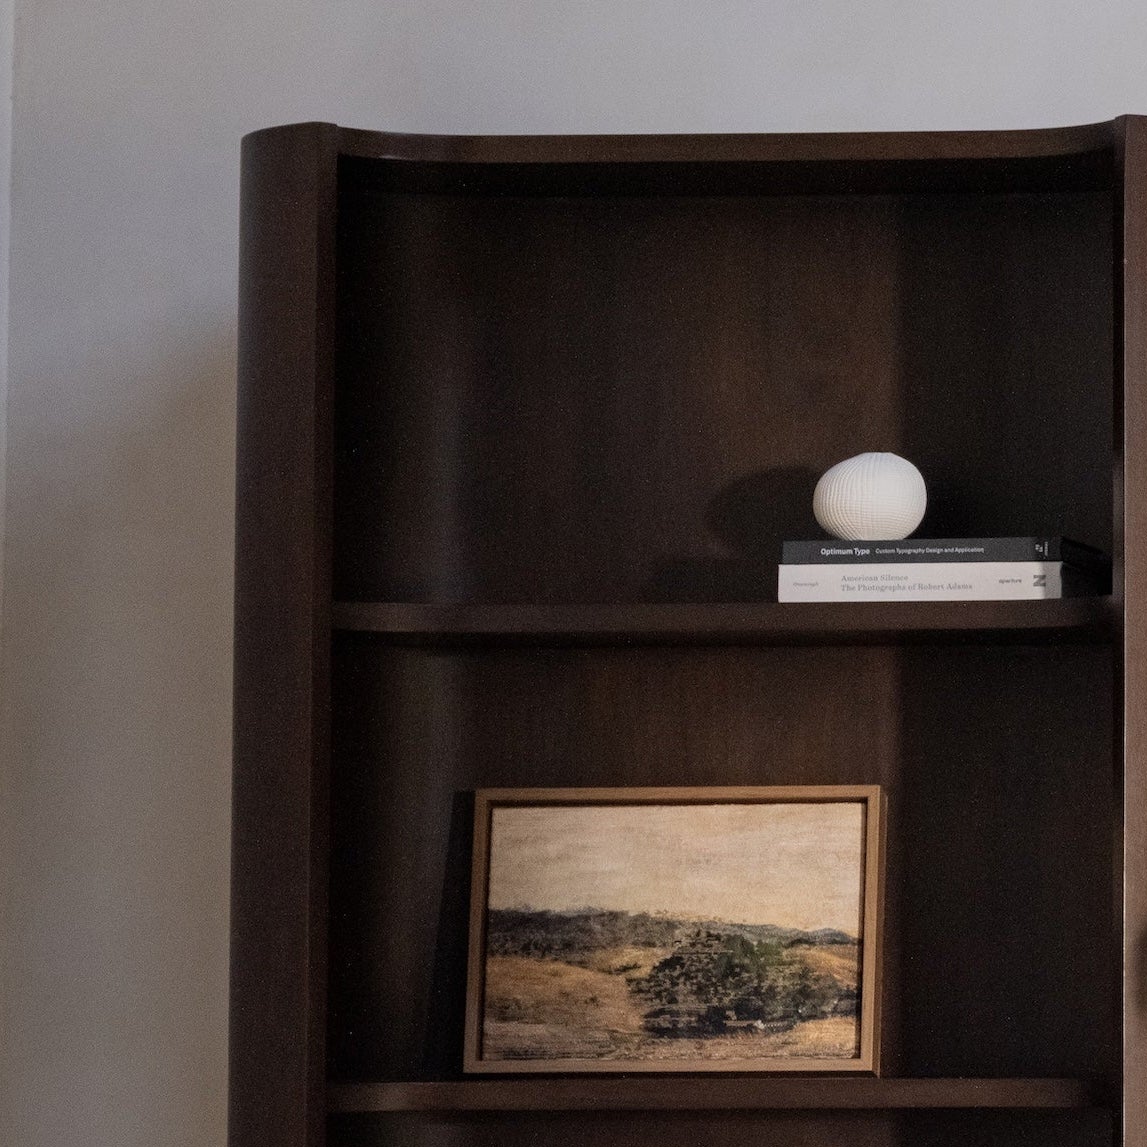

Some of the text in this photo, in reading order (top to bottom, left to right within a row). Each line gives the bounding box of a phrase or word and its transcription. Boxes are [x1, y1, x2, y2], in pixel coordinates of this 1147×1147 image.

[820, 547, 870, 557] Optimum Type
[880, 574, 908, 582] Silence
[841, 583, 855, 591] The
[857, 583, 906, 593] Photographs
[908, 583, 916, 591] of
[946, 582, 973, 590] Adams
